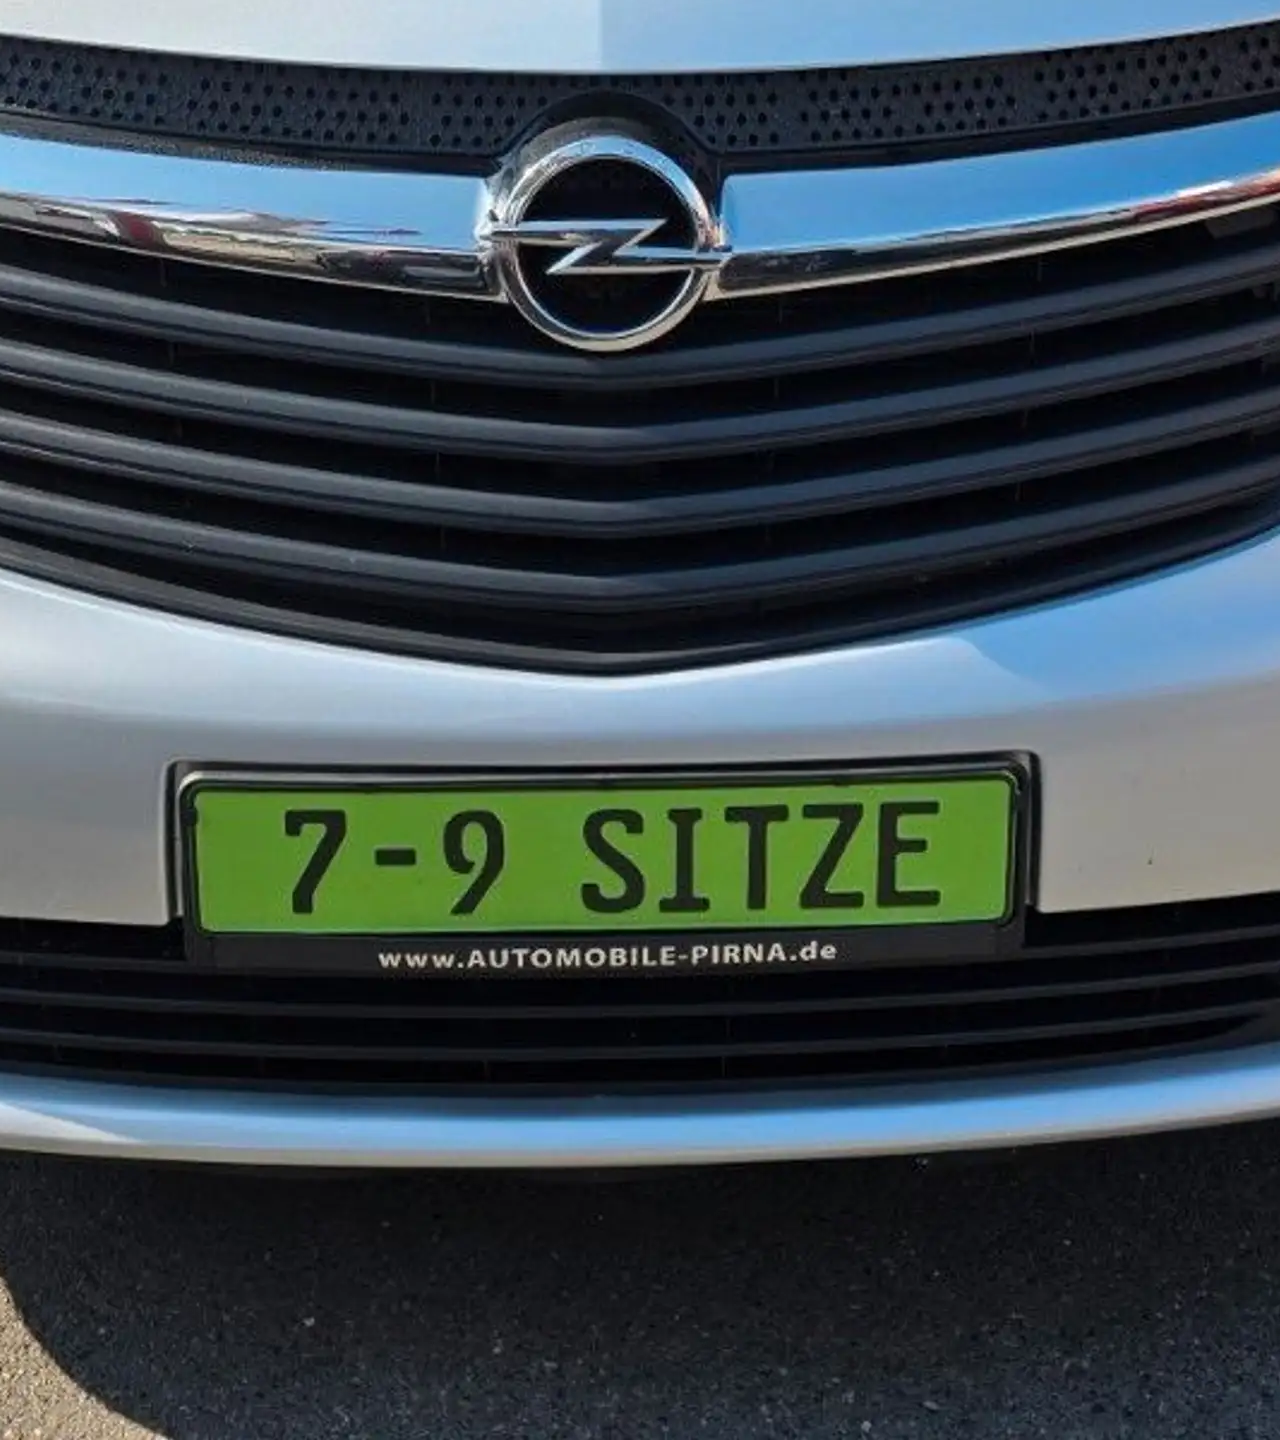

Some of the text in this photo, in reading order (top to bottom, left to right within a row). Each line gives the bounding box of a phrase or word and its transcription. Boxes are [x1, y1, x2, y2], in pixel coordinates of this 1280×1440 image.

[285, 801, 941, 914] 7-9 SITZE
[378, 940, 837, 970] www.AUTOMOBILE-PIRNA.de
